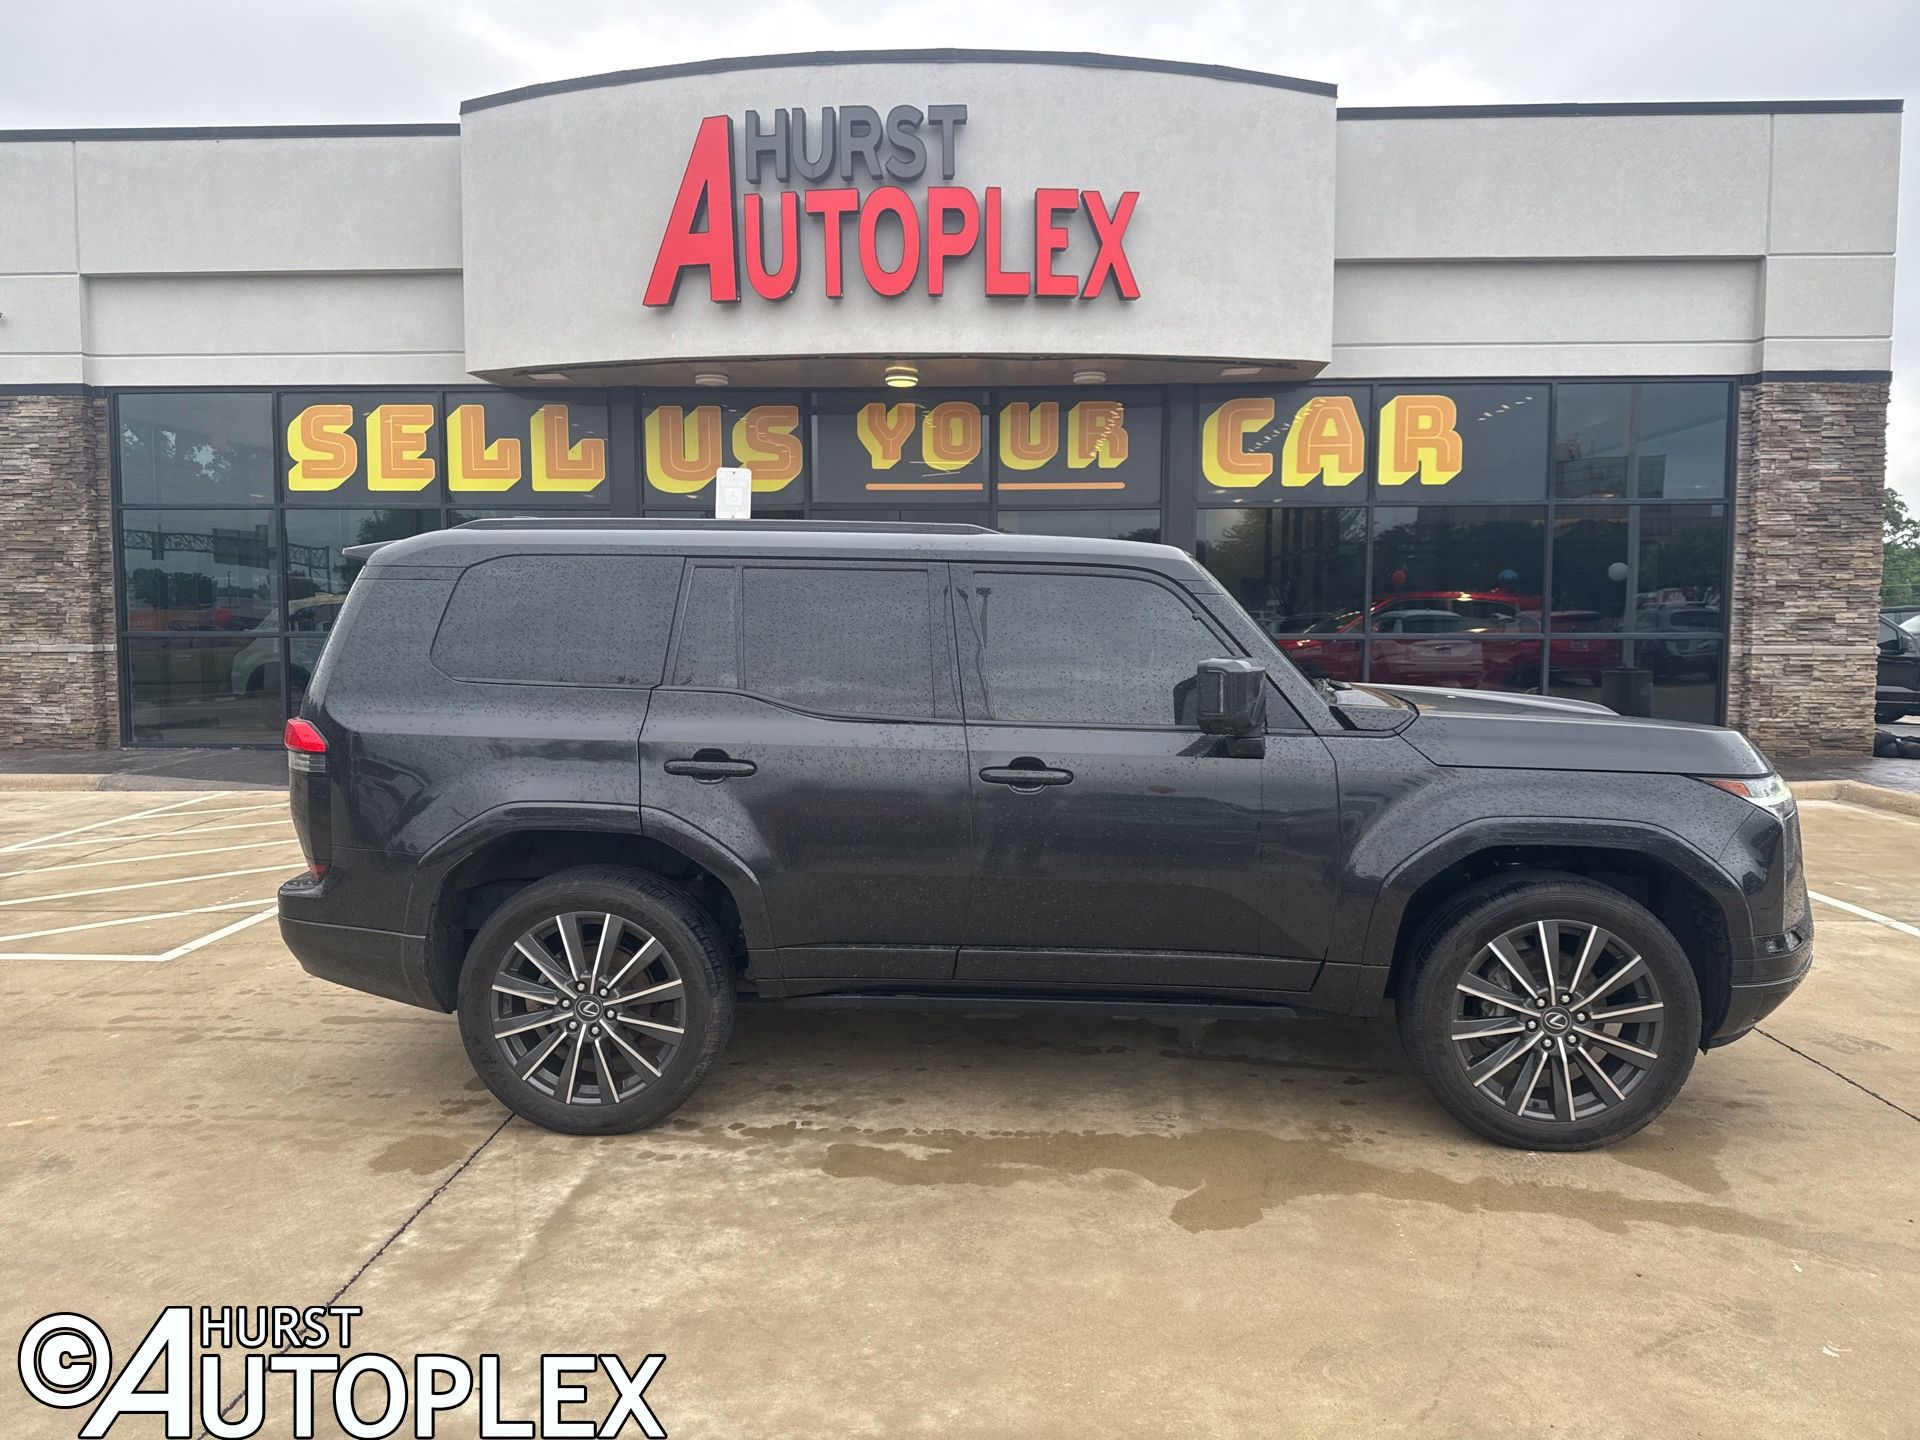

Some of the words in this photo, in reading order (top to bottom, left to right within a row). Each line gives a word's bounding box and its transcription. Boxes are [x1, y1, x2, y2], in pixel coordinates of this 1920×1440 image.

[745, 104, 968, 184] HURST
[642, 114, 1141, 307] AUTOPLEX
[287, 404, 606, 491] SELL
[645, 405, 803, 493] US
[857, 401, 1129, 470] YOUR
[1202, 395, 1463, 487] CAR
